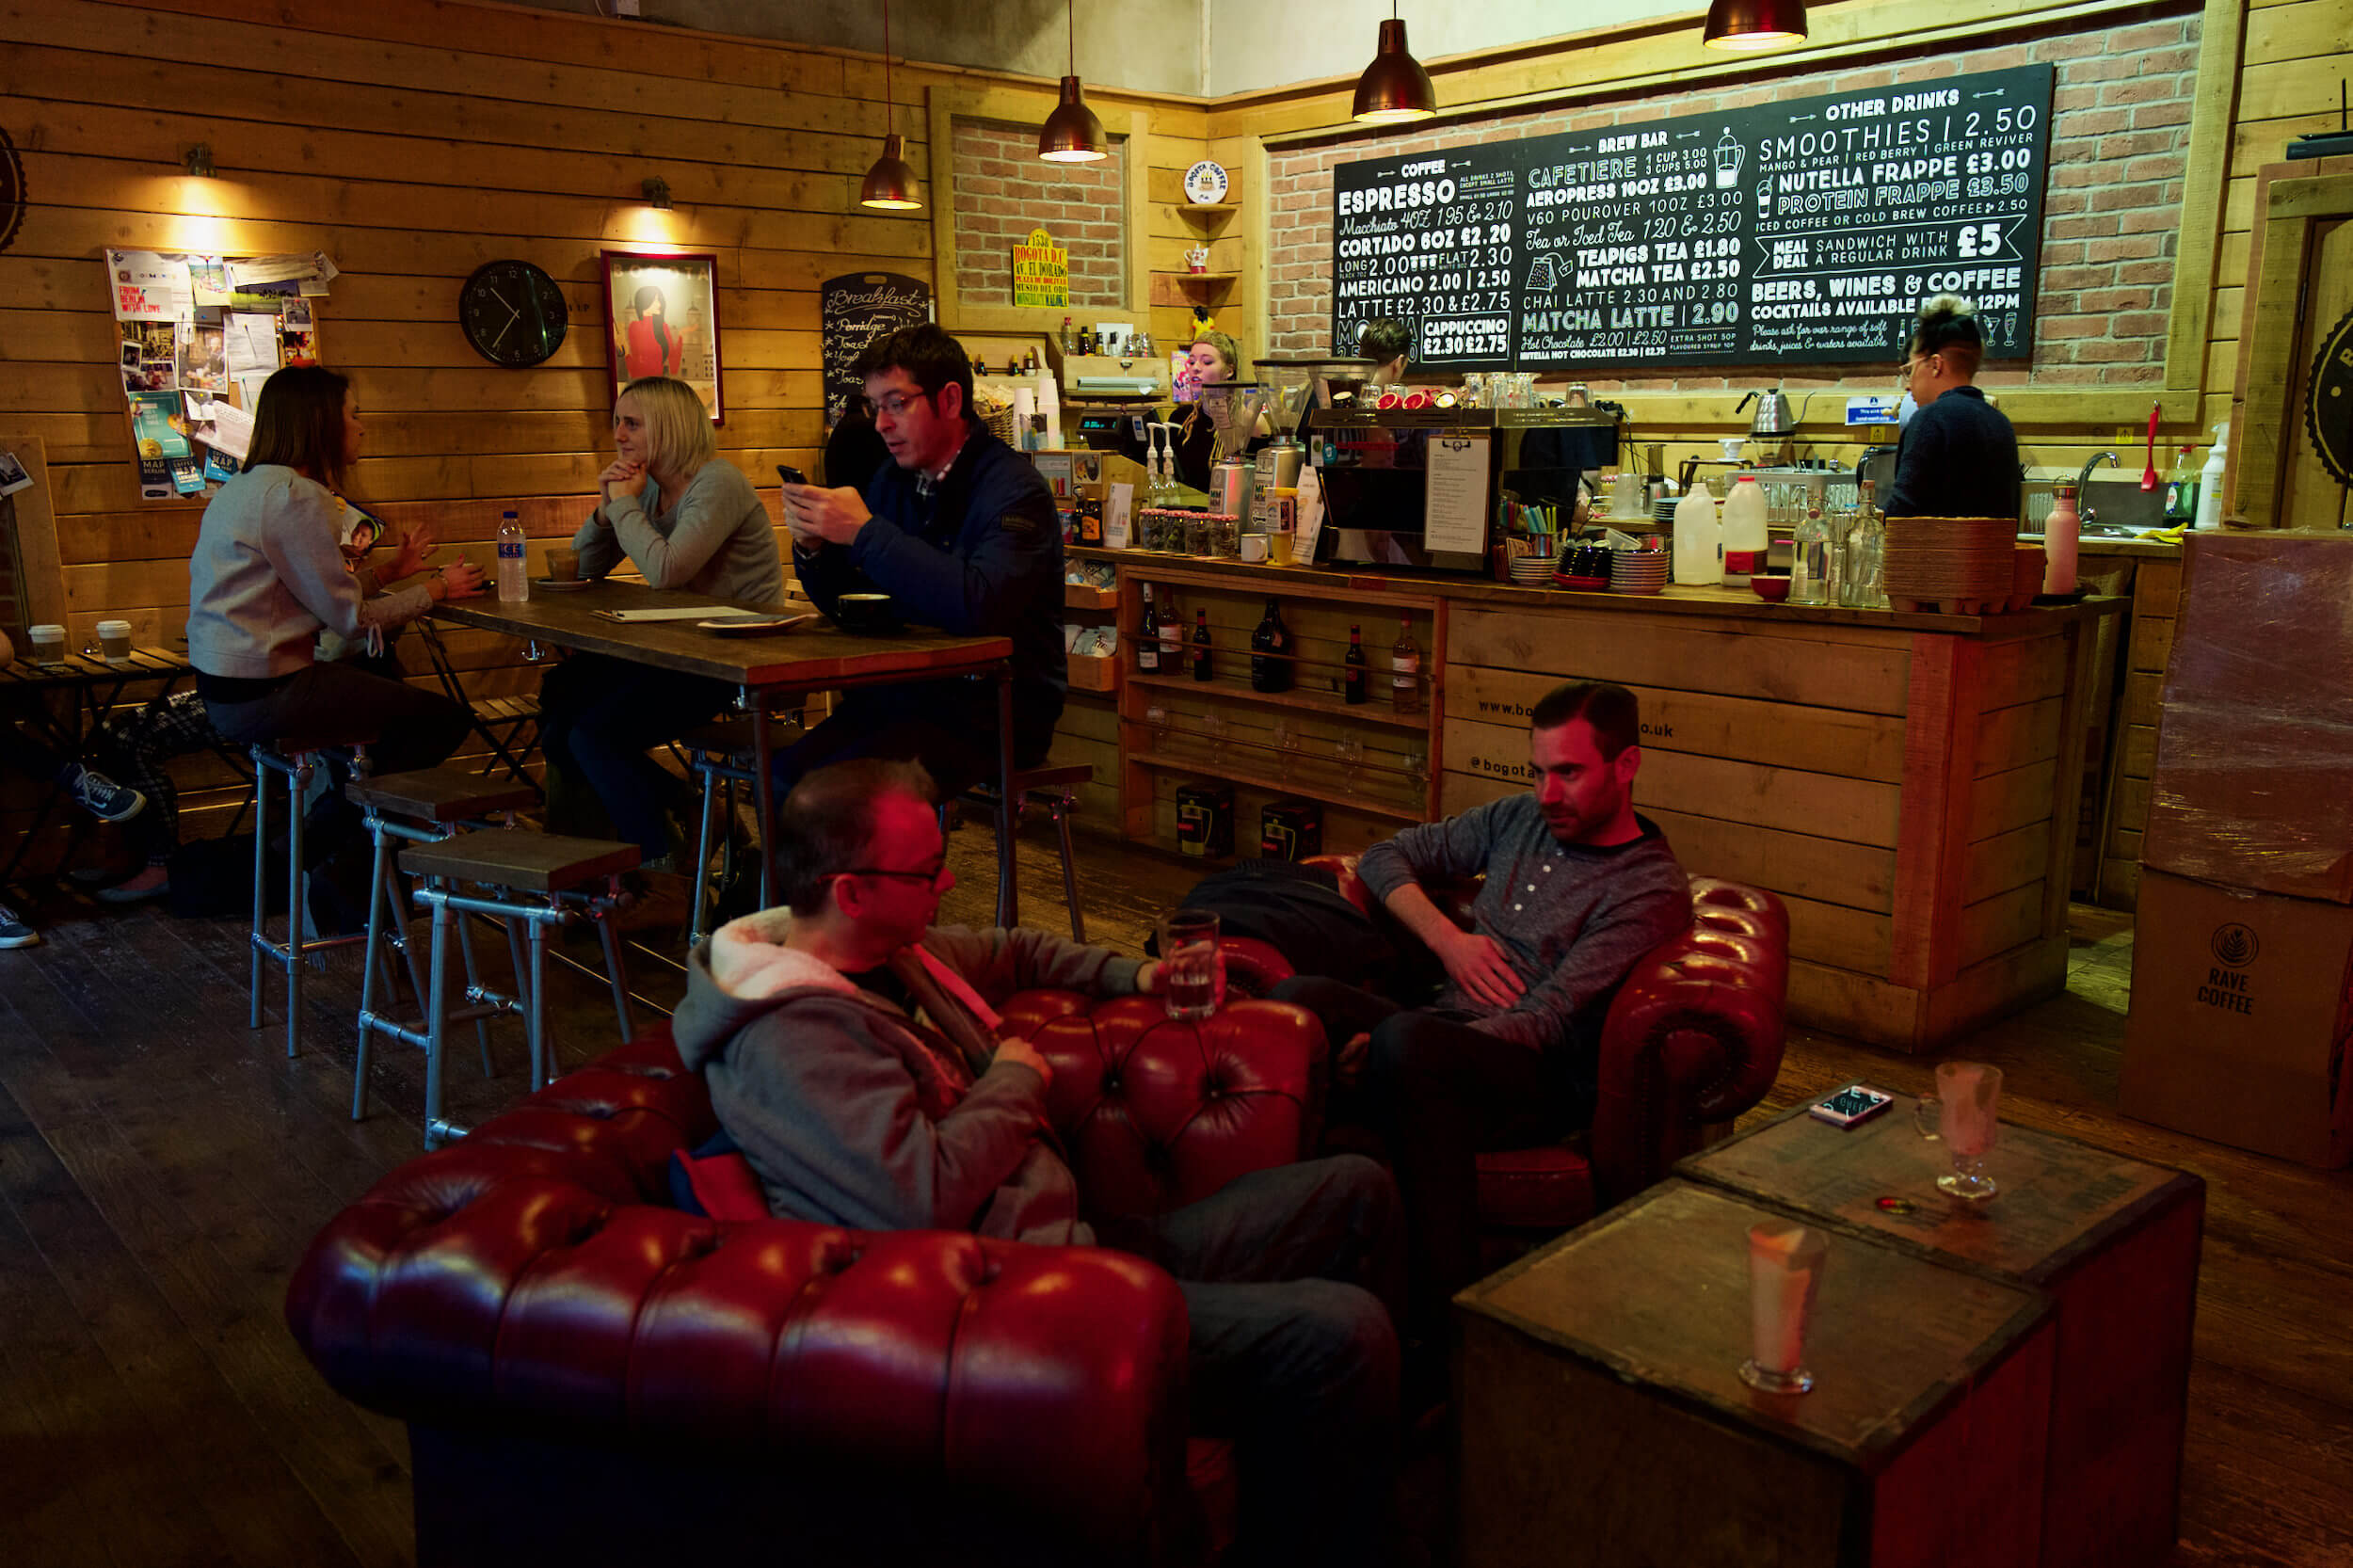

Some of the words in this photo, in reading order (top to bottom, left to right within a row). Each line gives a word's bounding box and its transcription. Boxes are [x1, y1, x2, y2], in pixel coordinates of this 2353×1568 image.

[1825, 98, 1886, 121] OTHER
[1892, 88, 1960, 114] DRINKS
[1597, 135, 1638, 154] BREW
[1641, 130, 1669, 149] BAR
[1758, 119, 1930, 162] SMOOTHIES
[1964, 104, 2036, 138] 2.50
[1656, 151, 1677, 164] CUP
[1682, 147, 1707, 160] 3.00
[1759, 160, 1796, 173] MANGO
[1800, 159, 1807, 168] &
[1812, 155, 1839, 168] PEAR
[1855, 150, 1876, 162] RED
[1881, 146, 1917, 160] BERRY
[1934, 139, 1973, 154] GREEN
[1979, 133, 2033, 148] REVIVER
[1401, 159, 1446, 178] COFFEE
[1528, 155, 1638, 189] CAFETIERE
[1656, 161, 1681, 174] CUPS
[1778, 167, 1865, 193] NUTELLA
[1872, 155, 1958, 184] FRAPPE
[1966, 148, 2031, 174] £3.00
[1338, 179, 1456, 216] ESPRESSO
[1526, 183, 1617, 208] AEROPRESS
[1664, 172, 1707, 193] £3.00
[1777, 187, 1868, 216] PROTEIN
[1875, 179, 1960, 207] FRAPPE
[1966, 171, 2029, 198] £3.50
[1339, 215, 1400, 235] Macchiato
[1466, 202, 1481, 223] &
[1527, 210, 1554, 226] V60
[1561, 200, 1641, 222] POUROVER
[1697, 191, 1743, 209] £3.00
[1755, 218, 1780, 232] ICED
[1785, 216, 1829, 230] COFFEE
[1833, 213, 1850, 226] OR
[1855, 210, 1886, 224] COLD
[1892, 207, 1927, 221] BREW
[1932, 202, 1982, 218] COFFEE
[1997, 199, 2028, 212] 2.50
[1338, 232, 1416, 258] CORTADO
[1461, 223, 1512, 247] £2.20
[1525, 227, 1551, 250] Tea
[1553, 234, 1571, 248] or
[1573, 224, 1605, 247] Iced
[1607, 220, 1635, 244] Tea
[1680, 214, 1698, 236] &
[1701, 210, 1742, 234] 2.50
[1816, 233, 1897, 253] SANDWICH
[1906, 230, 1949, 246] WITH
[1956, 223, 2002, 258] £5
[1015, 247, 1048, 264] BOGOTA
[1438, 250, 1469, 264] FLAT
[1469, 247, 1513, 268] 2.30
[1577, 244, 1649, 268] TEAPIGS
[1655, 241, 1689, 262] TEA
[1693, 237, 1741, 259] £1.80
[1772, 238, 1809, 256] MEAL
[1815, 254, 1824, 265] A
[1831, 248, 1894, 264] REGULAR
[1901, 244, 1948, 260] DRINK
[1039, 263, 1067, 278] DORADO
[1338, 259, 1368, 273] LONG
[1369, 256, 1410, 277] 2.00
[1576, 265, 1646, 289] MATCHA
[1651, 263, 1685, 282] TEA
[1690, 258, 1741, 280] £2.50
[1772, 253, 1808, 270] DEAL
[1338, 276, 1424, 297] AMERICANO
[1429, 273, 1461, 292] 2.00
[1478, 269, 1511, 289] 2.50
[1751, 280, 1822, 303] BEERS,
[1829, 274, 1897, 298] WINES
[1904, 274, 1923, 296] &
[1927, 266, 2022, 293] COFFEE
[827, 286, 921, 308] Breakfast
[1338, 298, 1393, 319] LATTE
[1397, 295, 1445, 315] £2.30
[1448, 296, 1458, 312] &
[1461, 291, 1511, 312] £2.75
[1523, 295, 1559, 311] CHAI
[1566, 290, 1615, 308] LATTE
[1624, 288, 1657, 304] 2.30
[1661, 285, 1696, 301] AND
[1701, 282, 1738, 299] 2.80
[1751, 301, 1832, 321] COCKTAILS
[1835, 296, 1916, 317] AVAILABLE
[1921, 295, 1972, 312] FM
[1977, 293, 2020, 310] 12PM
[836, 314, 887, 339] Porridge
[1424, 319, 1508, 337] CAPPUCCINO
[1521, 308, 1602, 333] MATCHA
[1610, 304, 1675, 329] LATTE
[1691, 300, 1739, 325] 2.90
[834, 334, 873, 349] Toast
[1521, 336, 1541, 351] Hot
[1542, 332, 1585, 350] Chocolate
[1589, 331, 1625, 348] £2.00
[1632, 329, 1668, 346] £2.50
[1697, 333, 1717, 342] SHOT
[1753, 324, 1780, 337] Please
[1781, 323, 1796, 335] ask
[1796, 323, 1812, 340] for
[1830, 325, 1858, 338] range
[1858, 319, 1869, 337] of
[1869, 319, 1888, 336] soft
[1816, 338, 1846, 349] waters
[1847, 334, 1888, 348] available
[1423, 336, 1464, 355] £2.30
[1465, 334, 1507, 354] £2.75
[1551, 348, 1568, 360] HOT
[1570, 346, 1617, 359] CHOCOLATE
[143, 459, 165, 469] MAP
[2209, 968, 2249, 991] RAVE
[2198, 986, 2253, 1015] COFFEE
